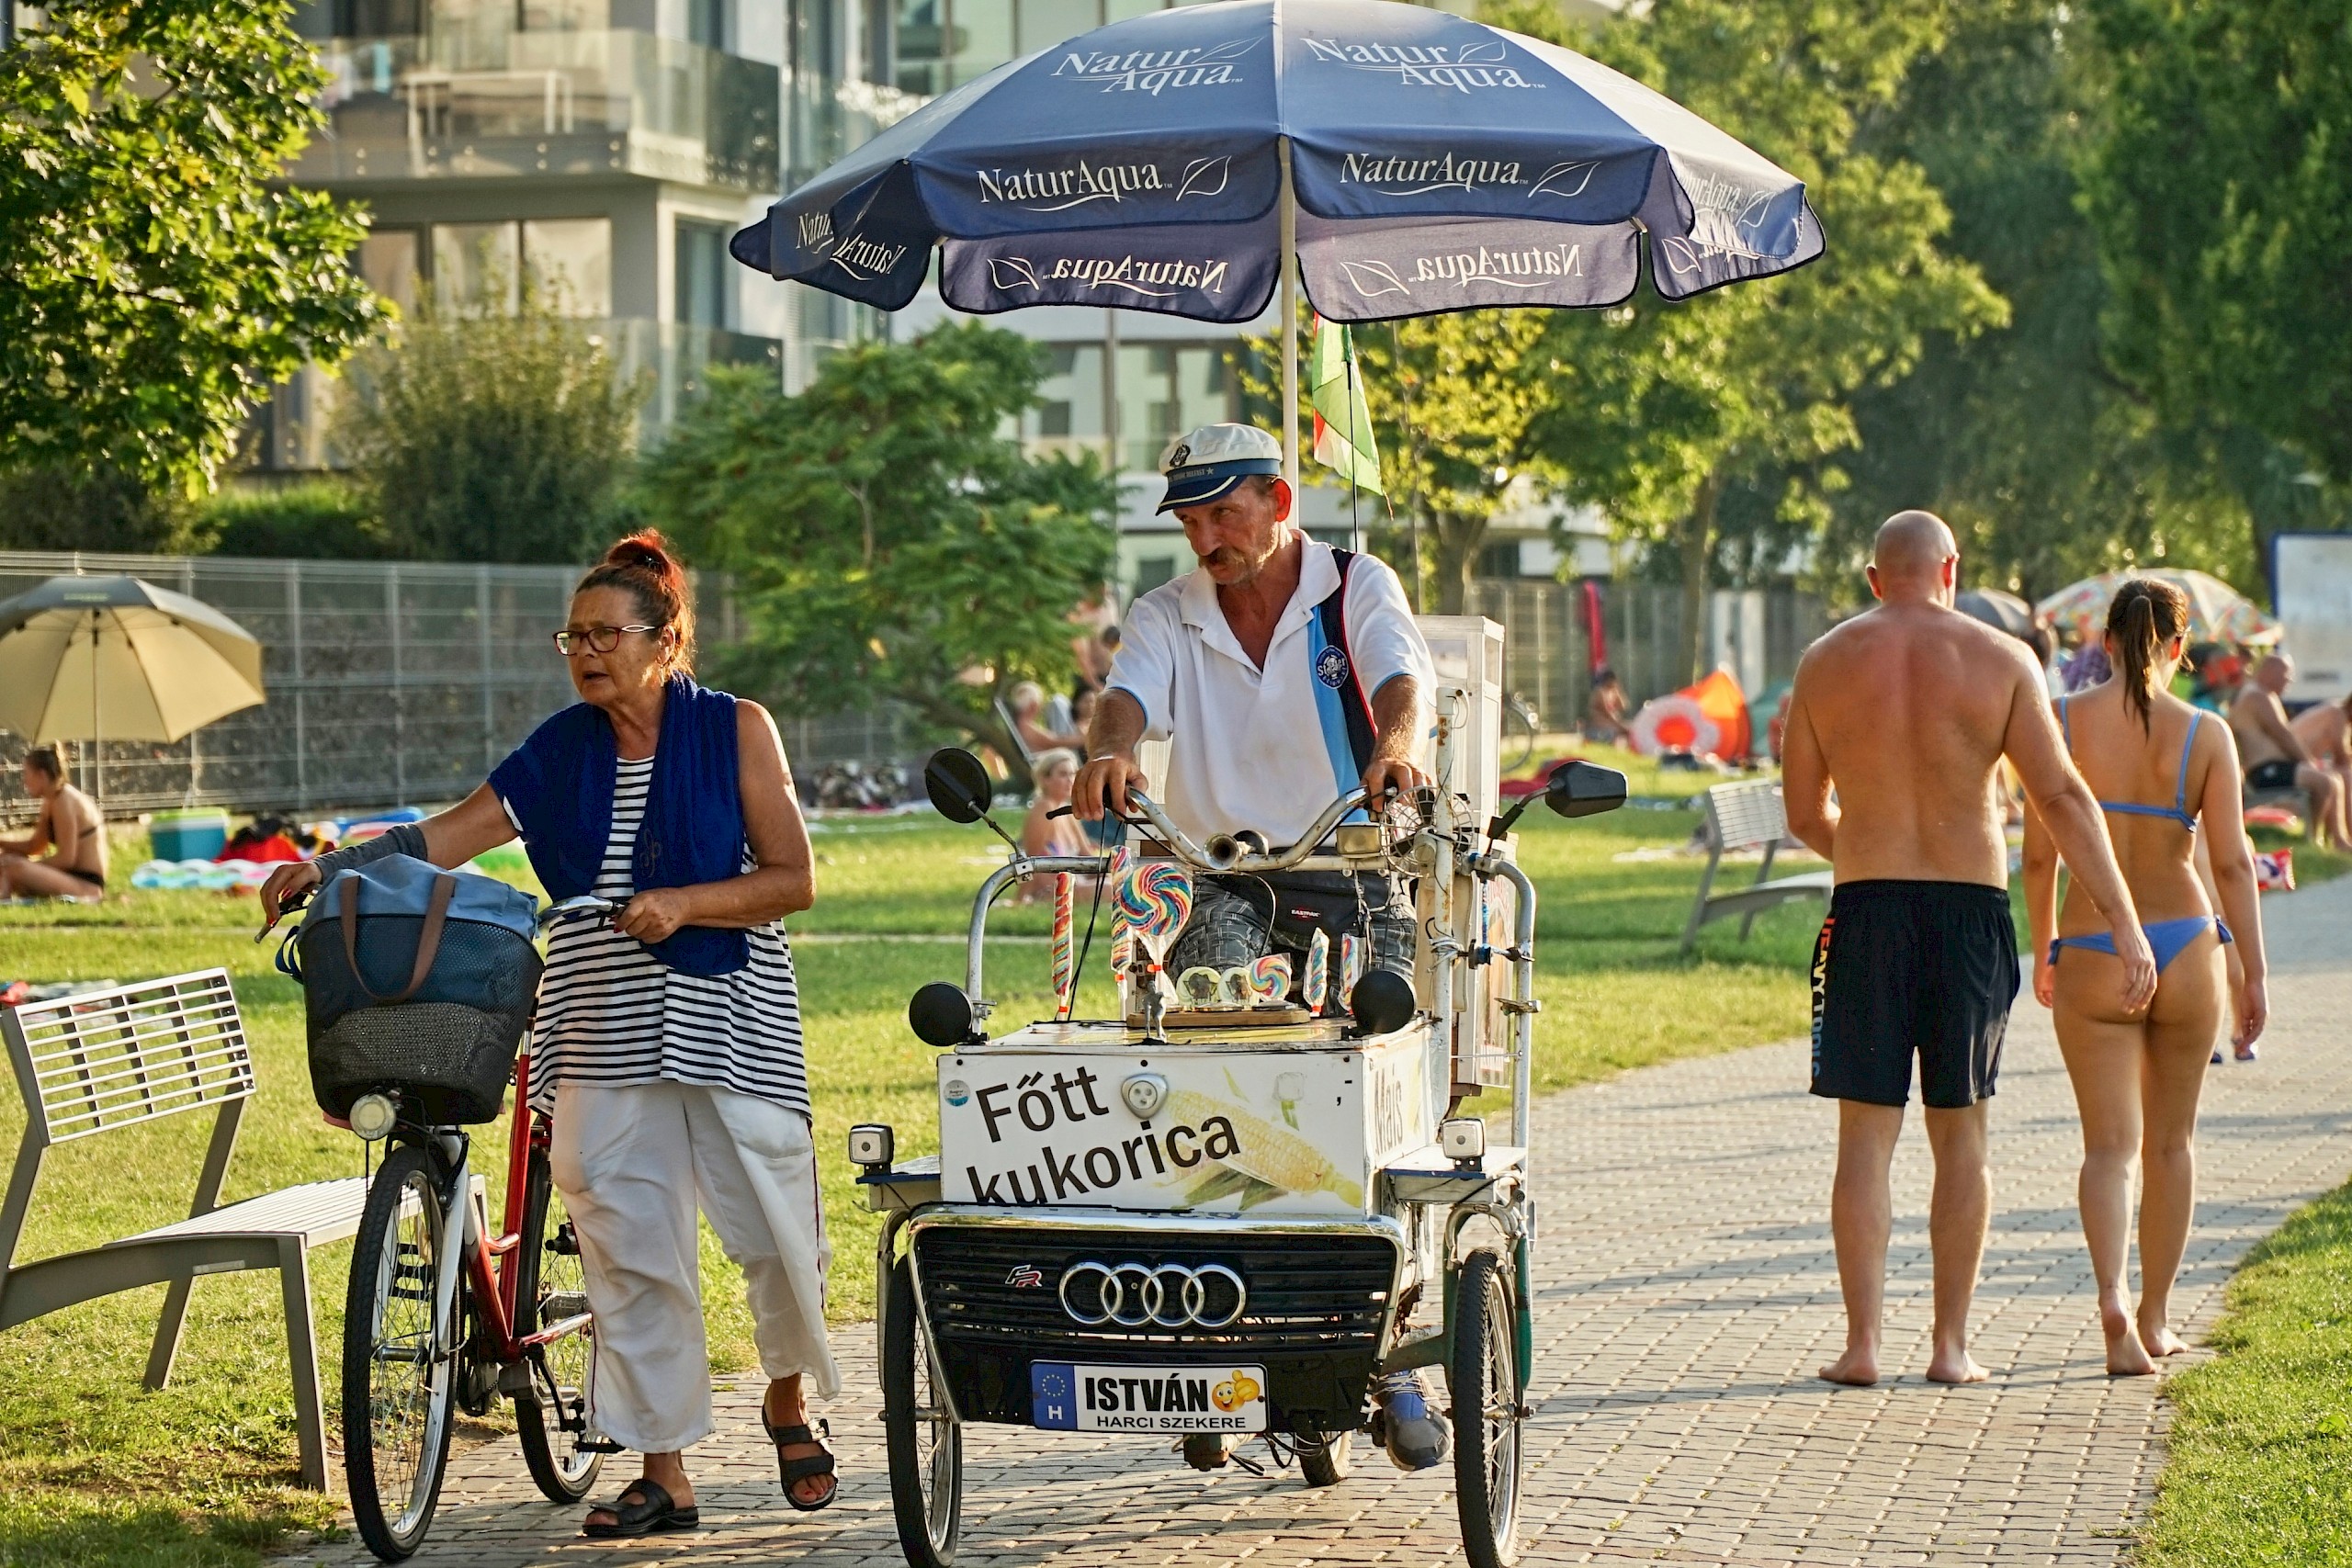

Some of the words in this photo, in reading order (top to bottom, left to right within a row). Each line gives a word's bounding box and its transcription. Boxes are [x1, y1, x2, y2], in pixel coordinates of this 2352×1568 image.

[1050, 48, 1201, 75] Natur
[1300, 38, 1449, 63] Natur
[1100, 64, 1234, 96] Aqua
[1400, 62, 1531, 95] Aqua
[976, 159, 1162, 203] NaturAqua
[1340, 152, 1521, 194] NaturAqua
[976, 1066, 1109, 1143] Főtt
[967, 1115, 1240, 1205] kukorica
[1084, 1372, 1209, 1413] ISTVÁN
[1047, 1404, 1063, 1420] H
[1097, 1416, 1153, 1428] HARCI
[1159, 1416, 1246, 1428] SZEKERE
